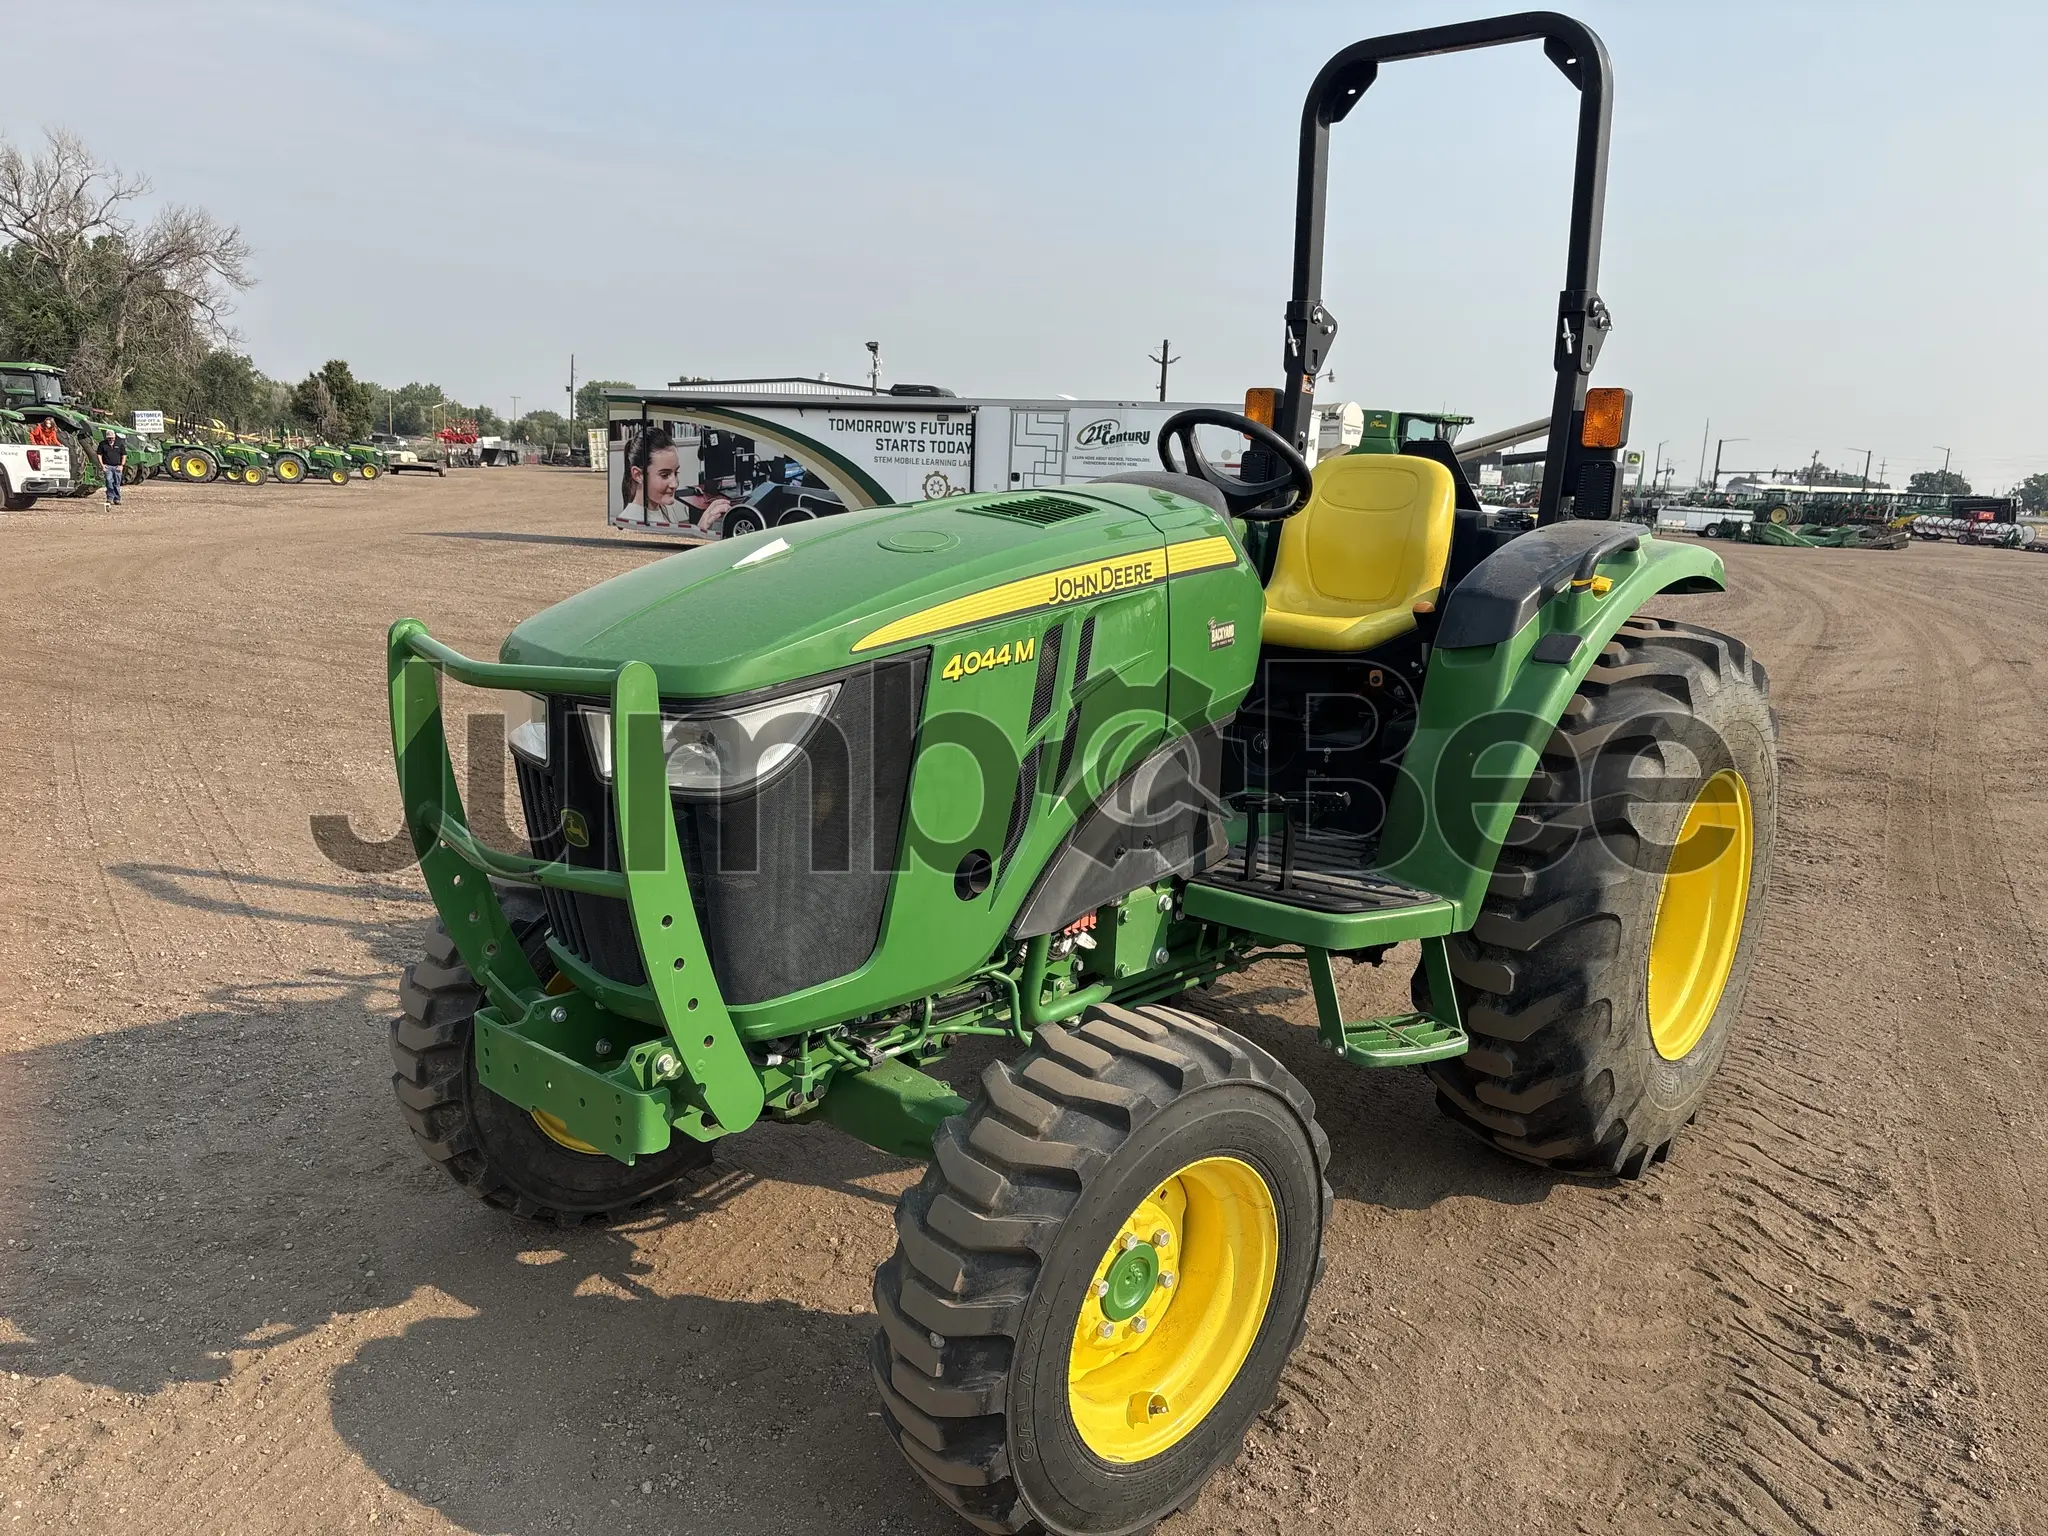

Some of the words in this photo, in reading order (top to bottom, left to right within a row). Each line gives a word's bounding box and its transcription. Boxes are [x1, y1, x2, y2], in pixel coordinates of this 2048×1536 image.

[828, 418, 916, 434] TOMORROW'S
[920, 422, 973, 436] FUTURE
[1083, 422, 1112, 445] 21st
[875, 438, 926, 453] STARTS
[929, 440, 973, 455] TODAY
[873, 456, 893, 464] STEM
[894, 457, 920, 465] MOBILE
[921, 458, 957, 467] LEARNING
[1051, 572, 1098, 601] JOHN
[1101, 561, 1153, 592] DEERE
[1015, 1291, 1050, 1463] GALAXY
